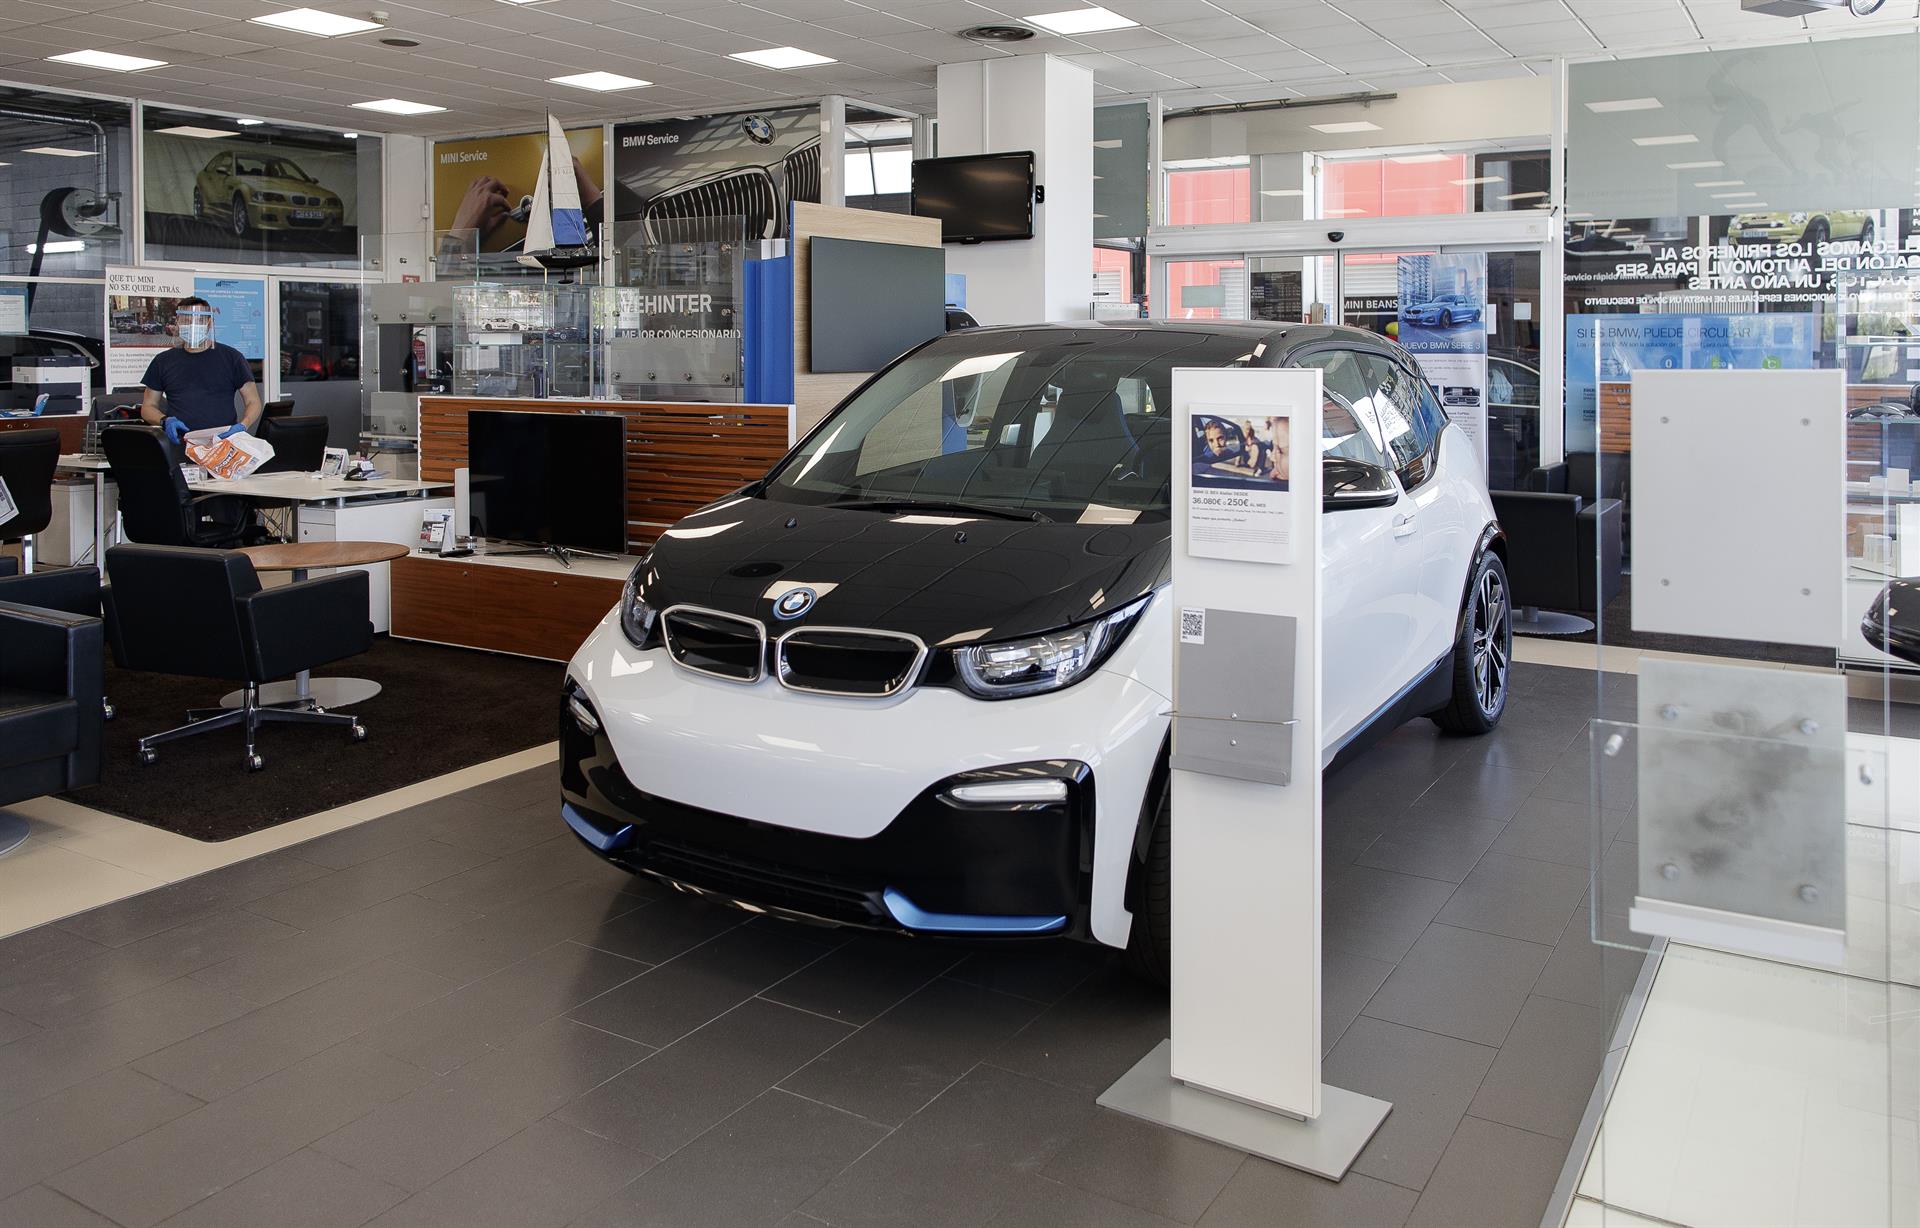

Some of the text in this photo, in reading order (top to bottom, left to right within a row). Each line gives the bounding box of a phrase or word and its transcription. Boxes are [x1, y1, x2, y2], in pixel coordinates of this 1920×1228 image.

[622, 133, 679, 147] BMW Service
[440, 150, 488, 164] MINI Service
[109, 274, 154, 284] QUE TU MINI
[109, 283, 182, 294] NO SE QUEDE ATRÁS.
[627, 294, 713, 313] EHINTER
[1344, 299, 1398, 309] MINI BEANS
[656, 328, 741, 339] CONCESIONARIO
[1576, 328, 1588, 339] SI
[1608, 327, 1641, 340] BMW,
[1643, 327, 1683, 338] PUEDE
[1687, 327, 1751, 338] CIRCULAR
[1401, 342, 1428, 350] NUEVO
[1430, 342, 1450, 350] BMW
[1451, 342, 1474, 350] SERIE
[1767, 358, 1777, 368] C
[1192, 497, 1222, 506] 36.080€
[1227, 498, 1249, 507] 250€
